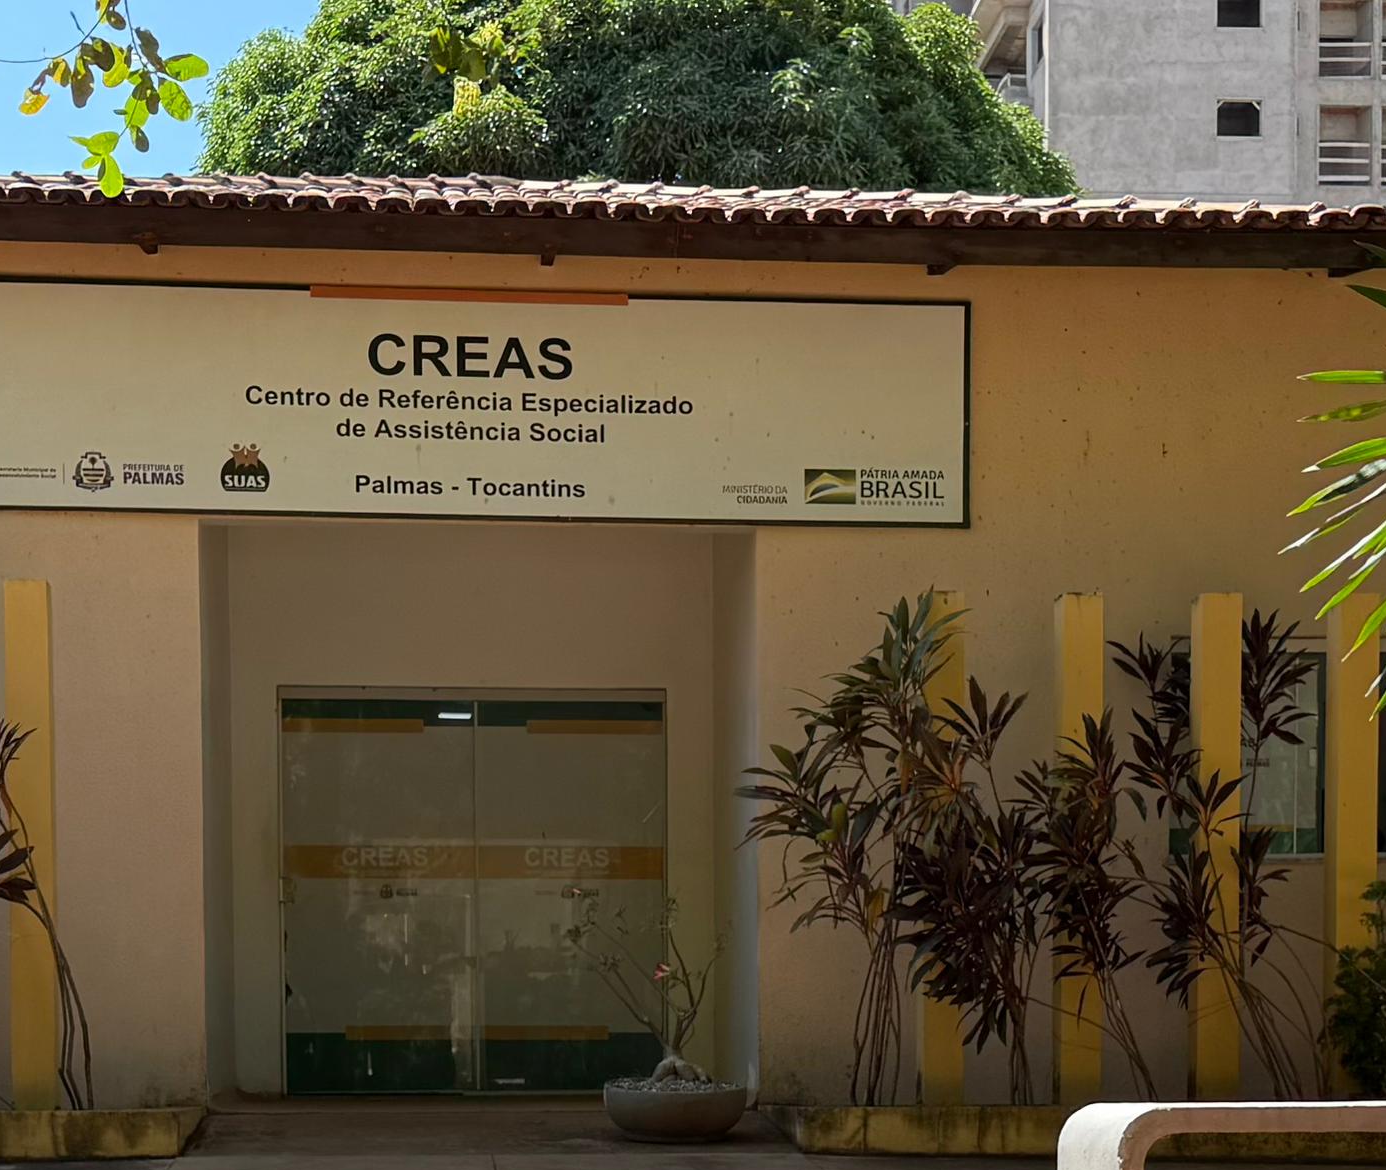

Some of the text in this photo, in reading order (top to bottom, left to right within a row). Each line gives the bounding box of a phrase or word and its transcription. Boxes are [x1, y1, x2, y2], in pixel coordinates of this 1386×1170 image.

[367, 333, 573, 380] CREAS
[245, 385, 694, 417] Centro de Referência Especializado
[336, 418, 605, 443] de Assistência Social
[122, 463, 185, 472] PREFEITURA DE
[860, 466, 945, 480] PÁTRIA AMADA
[123, 472, 185, 486] PALMAS
[224, 474, 266, 488] SUAS
[355, 474, 443, 494] Palmas
[466, 477, 586, 498] Tocantins
[722, 484, 788, 495] MINISTÉRIO DA
[860, 480, 945, 499] BRASIL
[736, 495, 788, 505] CIDADANIA
[341, 847, 429, 867] CREAS
[524, 847, 610, 867] CREAS
